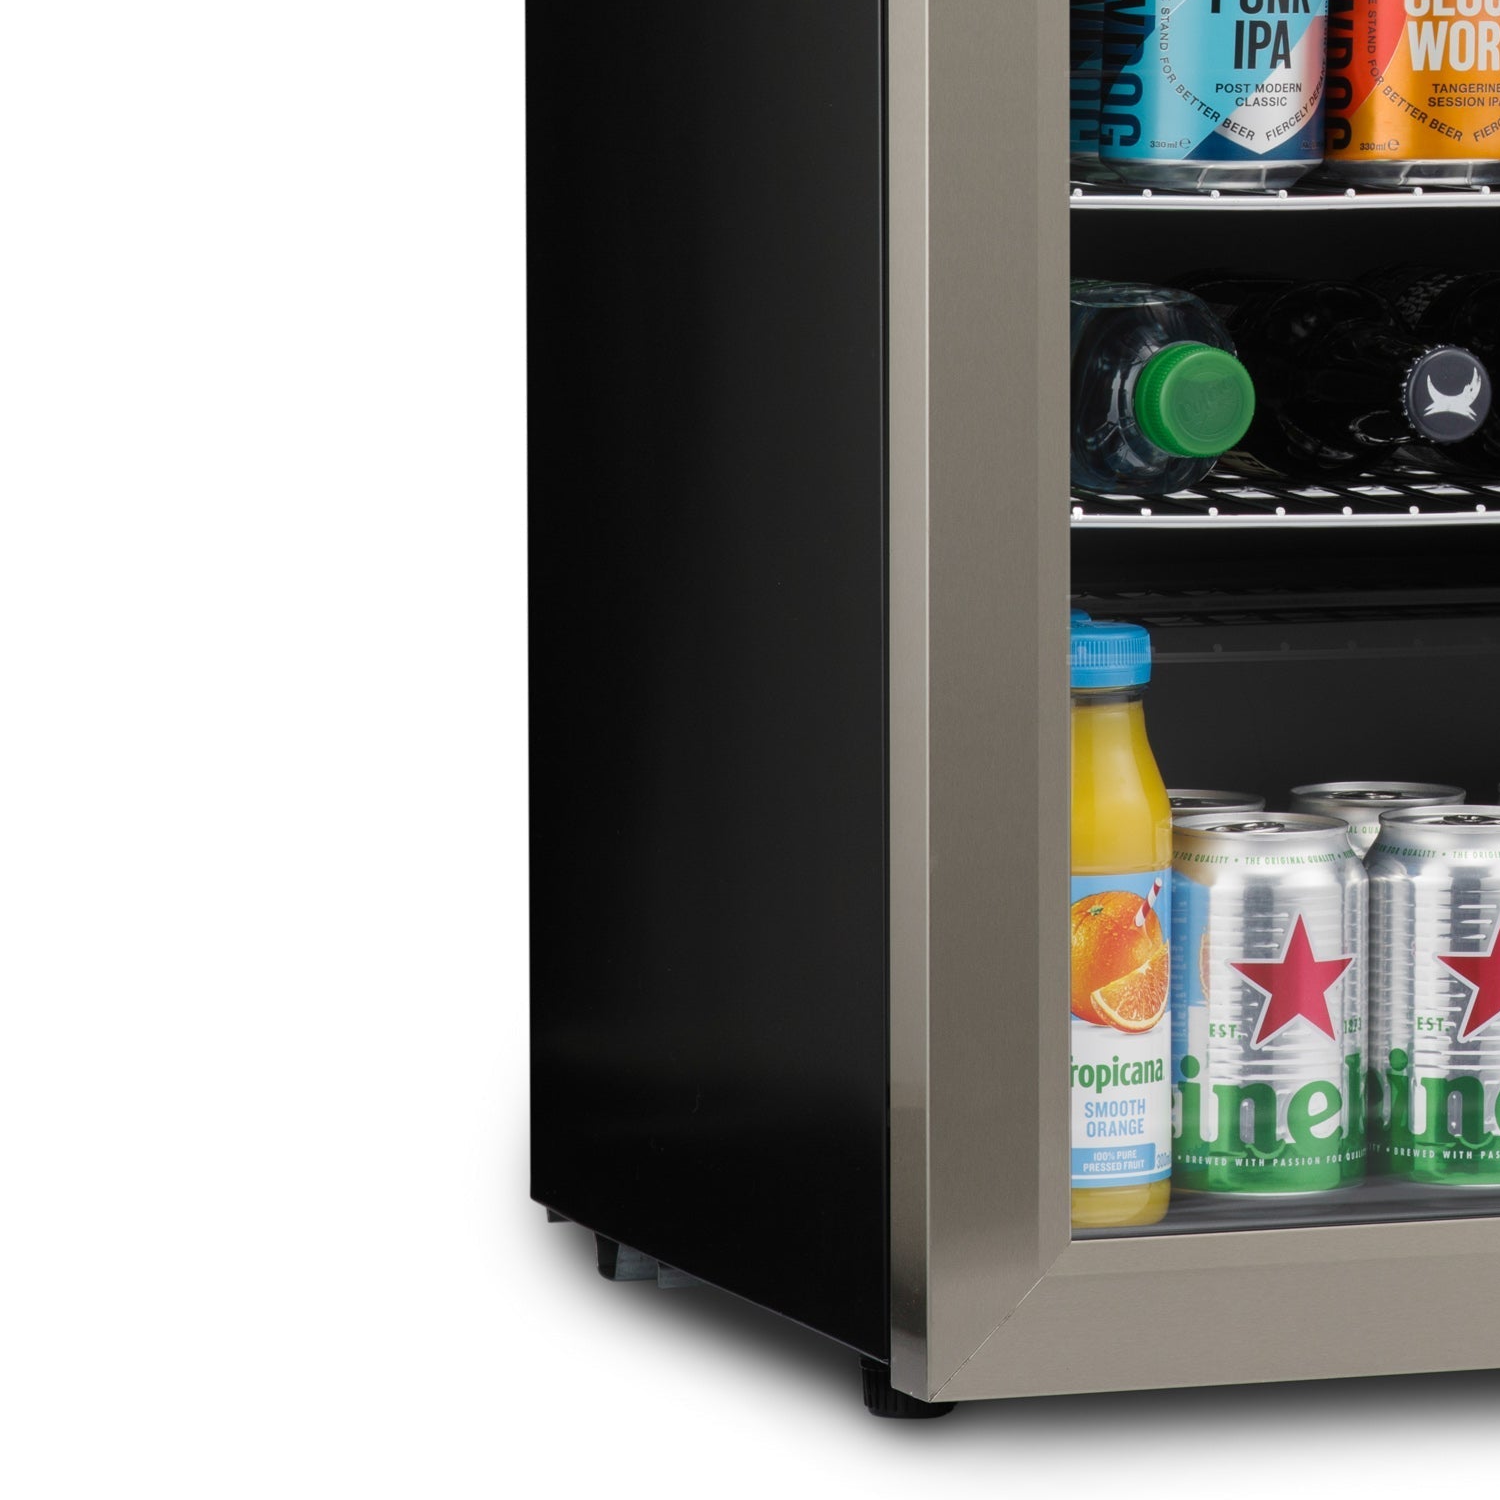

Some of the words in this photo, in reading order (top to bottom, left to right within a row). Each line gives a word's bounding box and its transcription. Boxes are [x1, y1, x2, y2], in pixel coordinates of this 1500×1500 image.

[1159, 7, 1170, 51] STAND
[1233, 20, 1292, 70] IPA
[1159, 57, 1177, 84] FOR
[1215, 83, 1251, 93] POST
[1255, 82, 1302, 93] MODERN
[1175, 84, 1221, 123] BETTER
[1235, 96, 1288, 107] CLASSIC
[1428, 97, 1485, 107] SESSION
[1265, 104, 1309, 141] FIERCELY
[1382, 85, 1428, 124] BETTER
[1428, 118, 1464, 142] BEER
[1221, 118, 1256, 141] BEER
[1209, 1023, 1242, 1039] EST.
[1417, 1017, 1450, 1032] EST.
[1070, 1055, 1163, 1093] ropicana
[1084, 1098, 1146, 1119] SMOOTH
[1086, 1118, 1144, 1137] ORANGE
[1116, 1149, 1137, 1160] PURE
[1185, 1154, 1227, 1166] BREWED
[1235, 1157, 1265, 1167] WITH
[1273, 1156, 1321, 1167] PASSION
[1326, 1154, 1343, 1164] FOR
[1083, 1162, 1121, 1172] PRESSED
[1123, 1160, 1144, 1170] FRUIT
